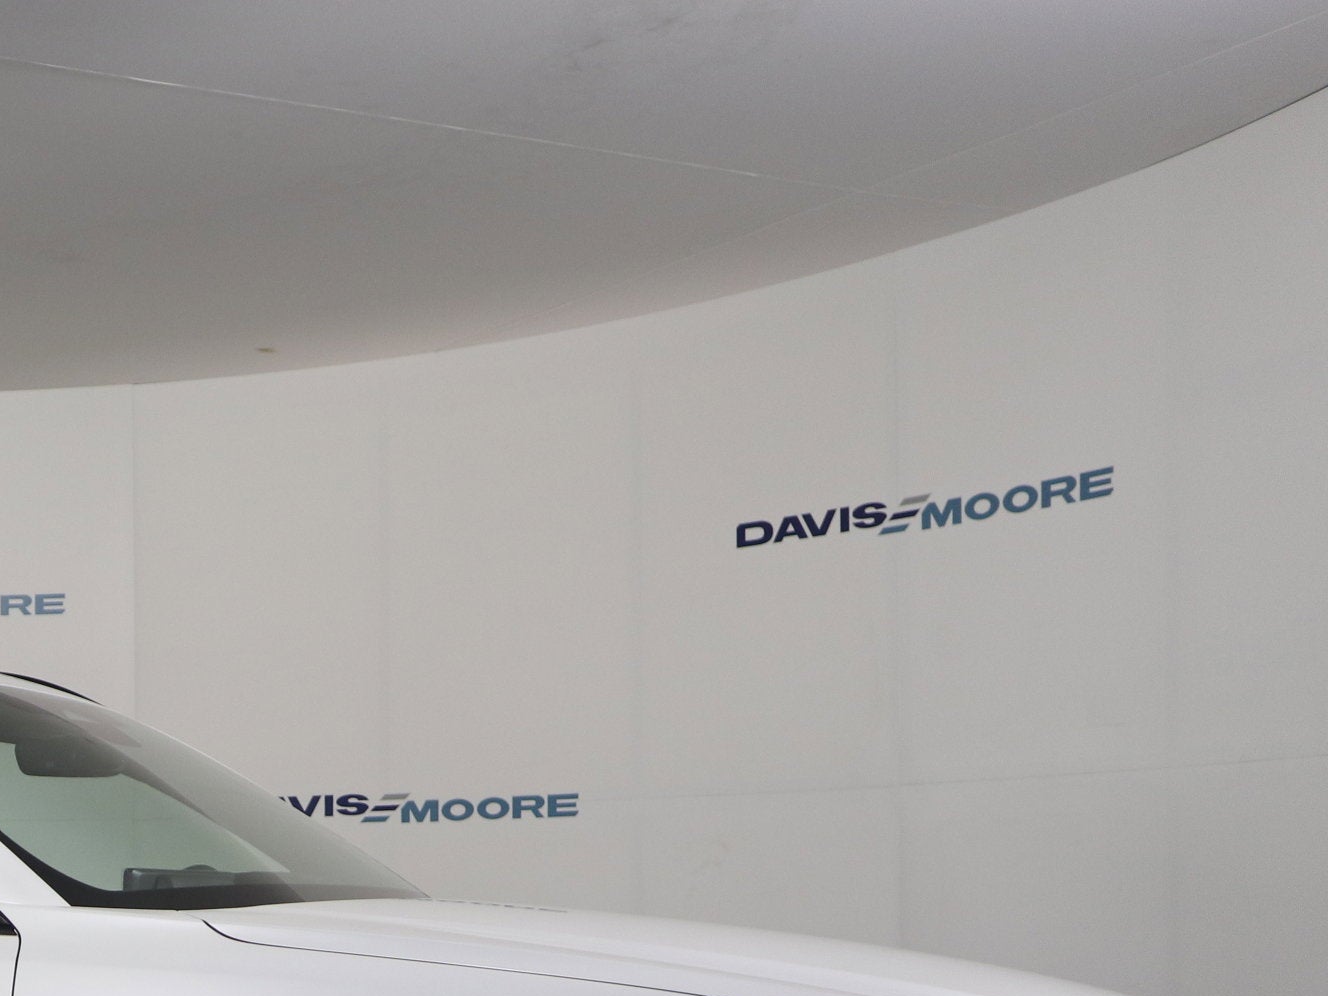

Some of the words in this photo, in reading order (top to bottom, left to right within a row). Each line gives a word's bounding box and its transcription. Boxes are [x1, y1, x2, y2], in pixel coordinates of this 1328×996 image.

[736, 502, 887, 548] DAVIS
[921, 466, 1114, 530] MOORE
[279, 793, 370, 818] VIS
[401, 793, 580, 823] MOORE
